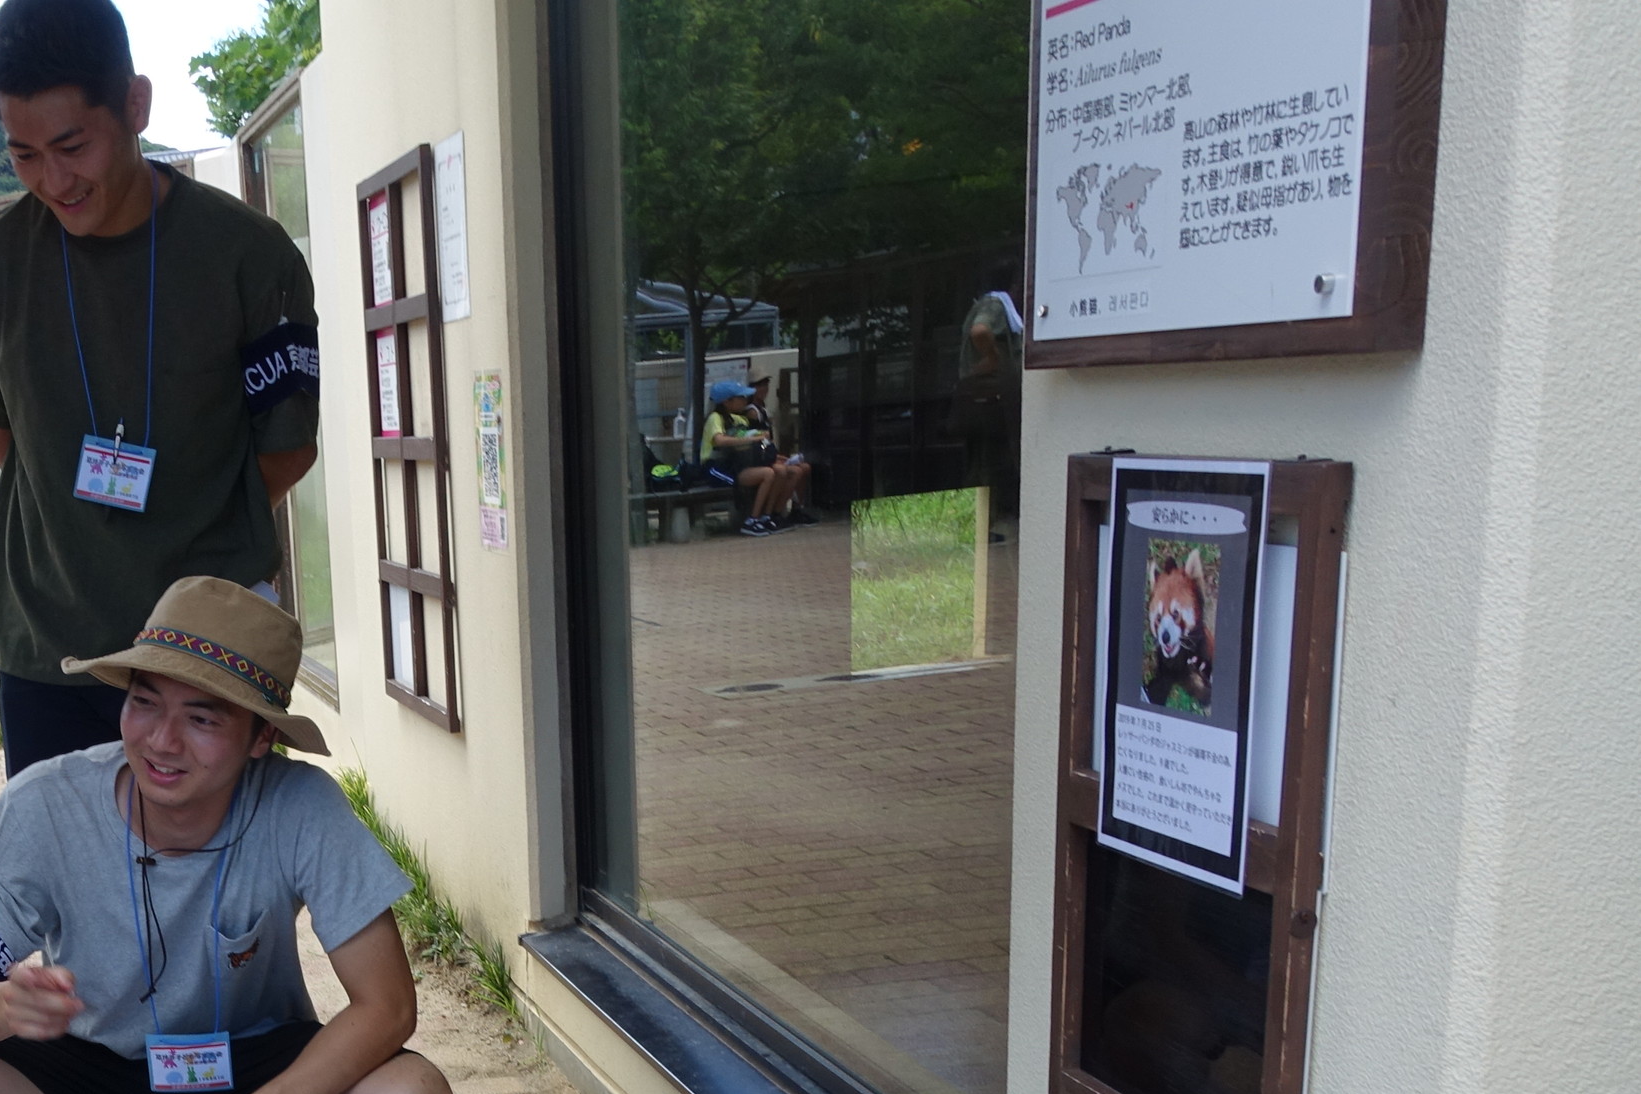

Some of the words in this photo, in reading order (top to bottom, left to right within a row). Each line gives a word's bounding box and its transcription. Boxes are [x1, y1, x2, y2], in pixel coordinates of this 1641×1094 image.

[1098, 15, 1131, 43] Panda
[1118, 48, 1162, 76] fulgens
[1184, 84, 1349, 142] 高山の森林や竹林に生息してい
[245, 351, 288, 395] CUA
